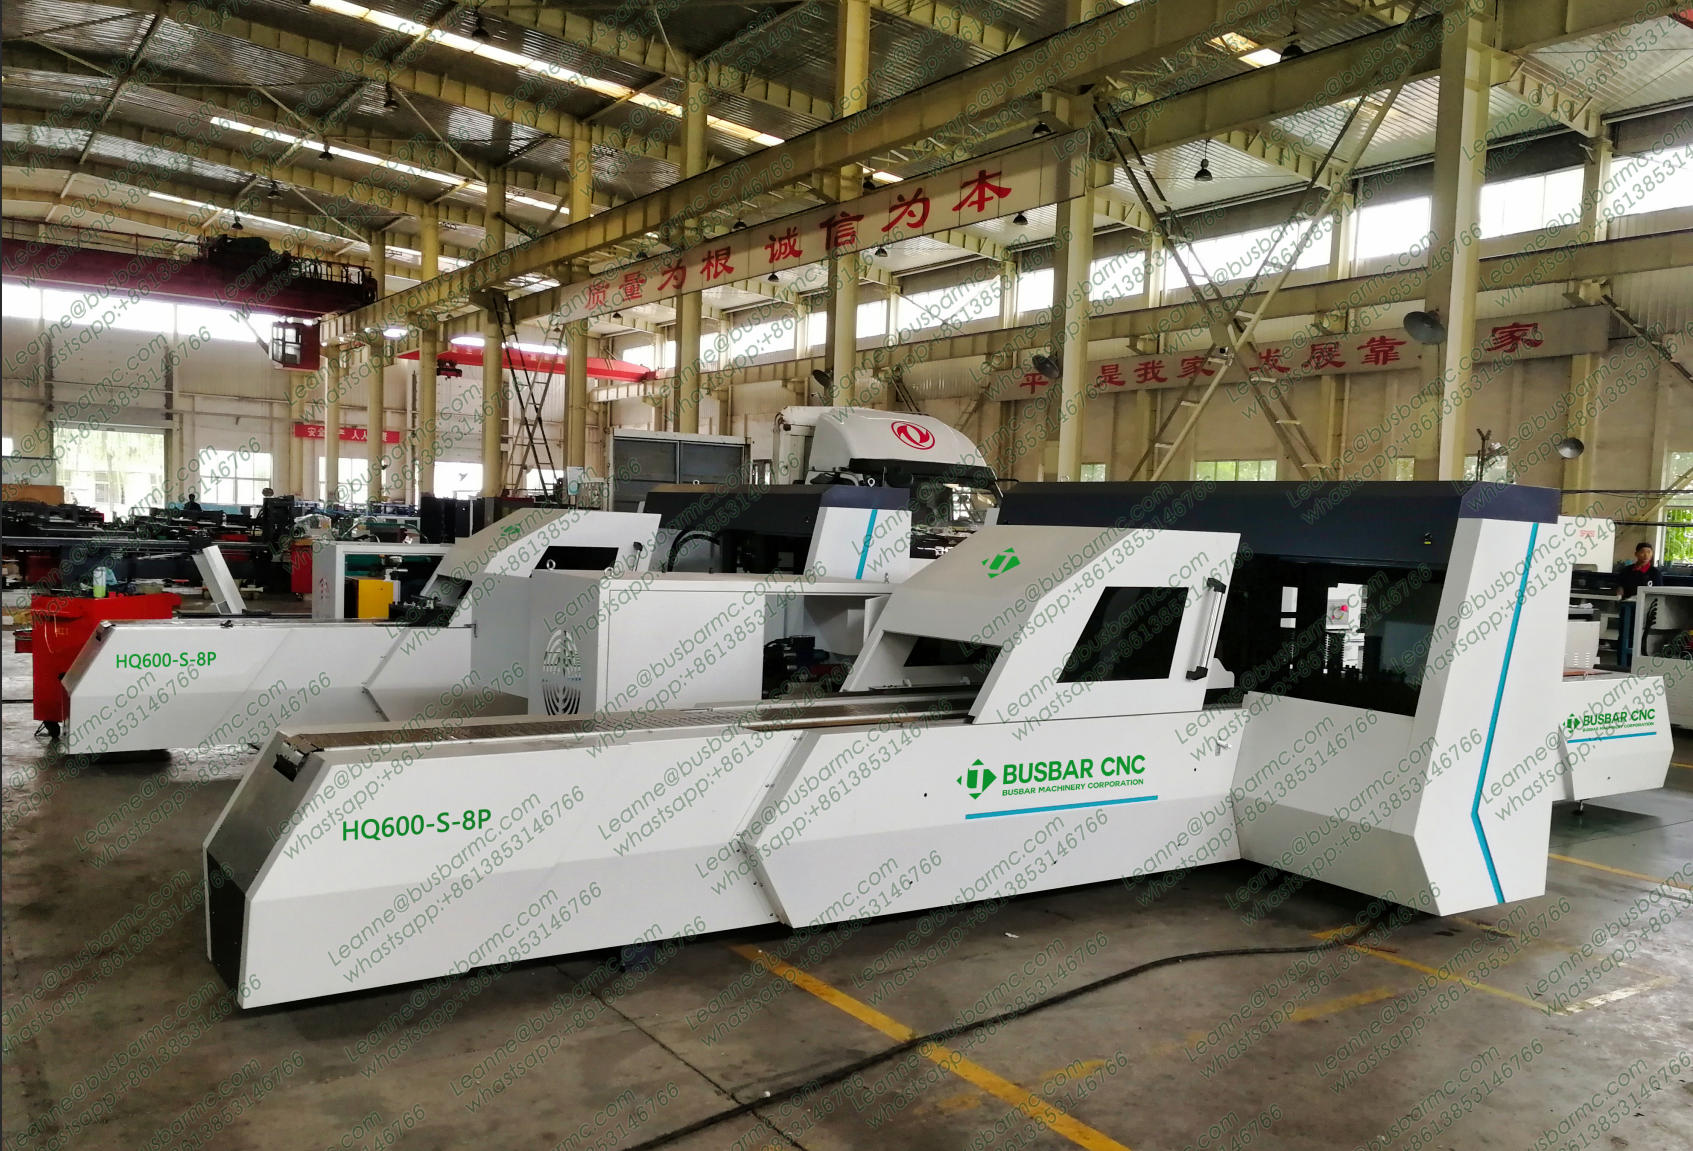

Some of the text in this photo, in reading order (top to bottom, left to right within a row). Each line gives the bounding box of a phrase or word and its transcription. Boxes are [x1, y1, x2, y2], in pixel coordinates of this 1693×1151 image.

[585, 169, 1012, 311] 质量为根 诚信为本
[1019, 321, 1544, 395] 平是我家 发展靠家
[115, 650, 217, 670] HQ600-S-8P
[1583, 708, 1656, 727] BUSBAR CNC
[1002, 754, 1146, 785] BUSBAR CNC
[1002, 778, 1144, 796] BUSBAR MACHINERY CORPORATION
[342, 808, 492, 841] HQ600-S-8P
